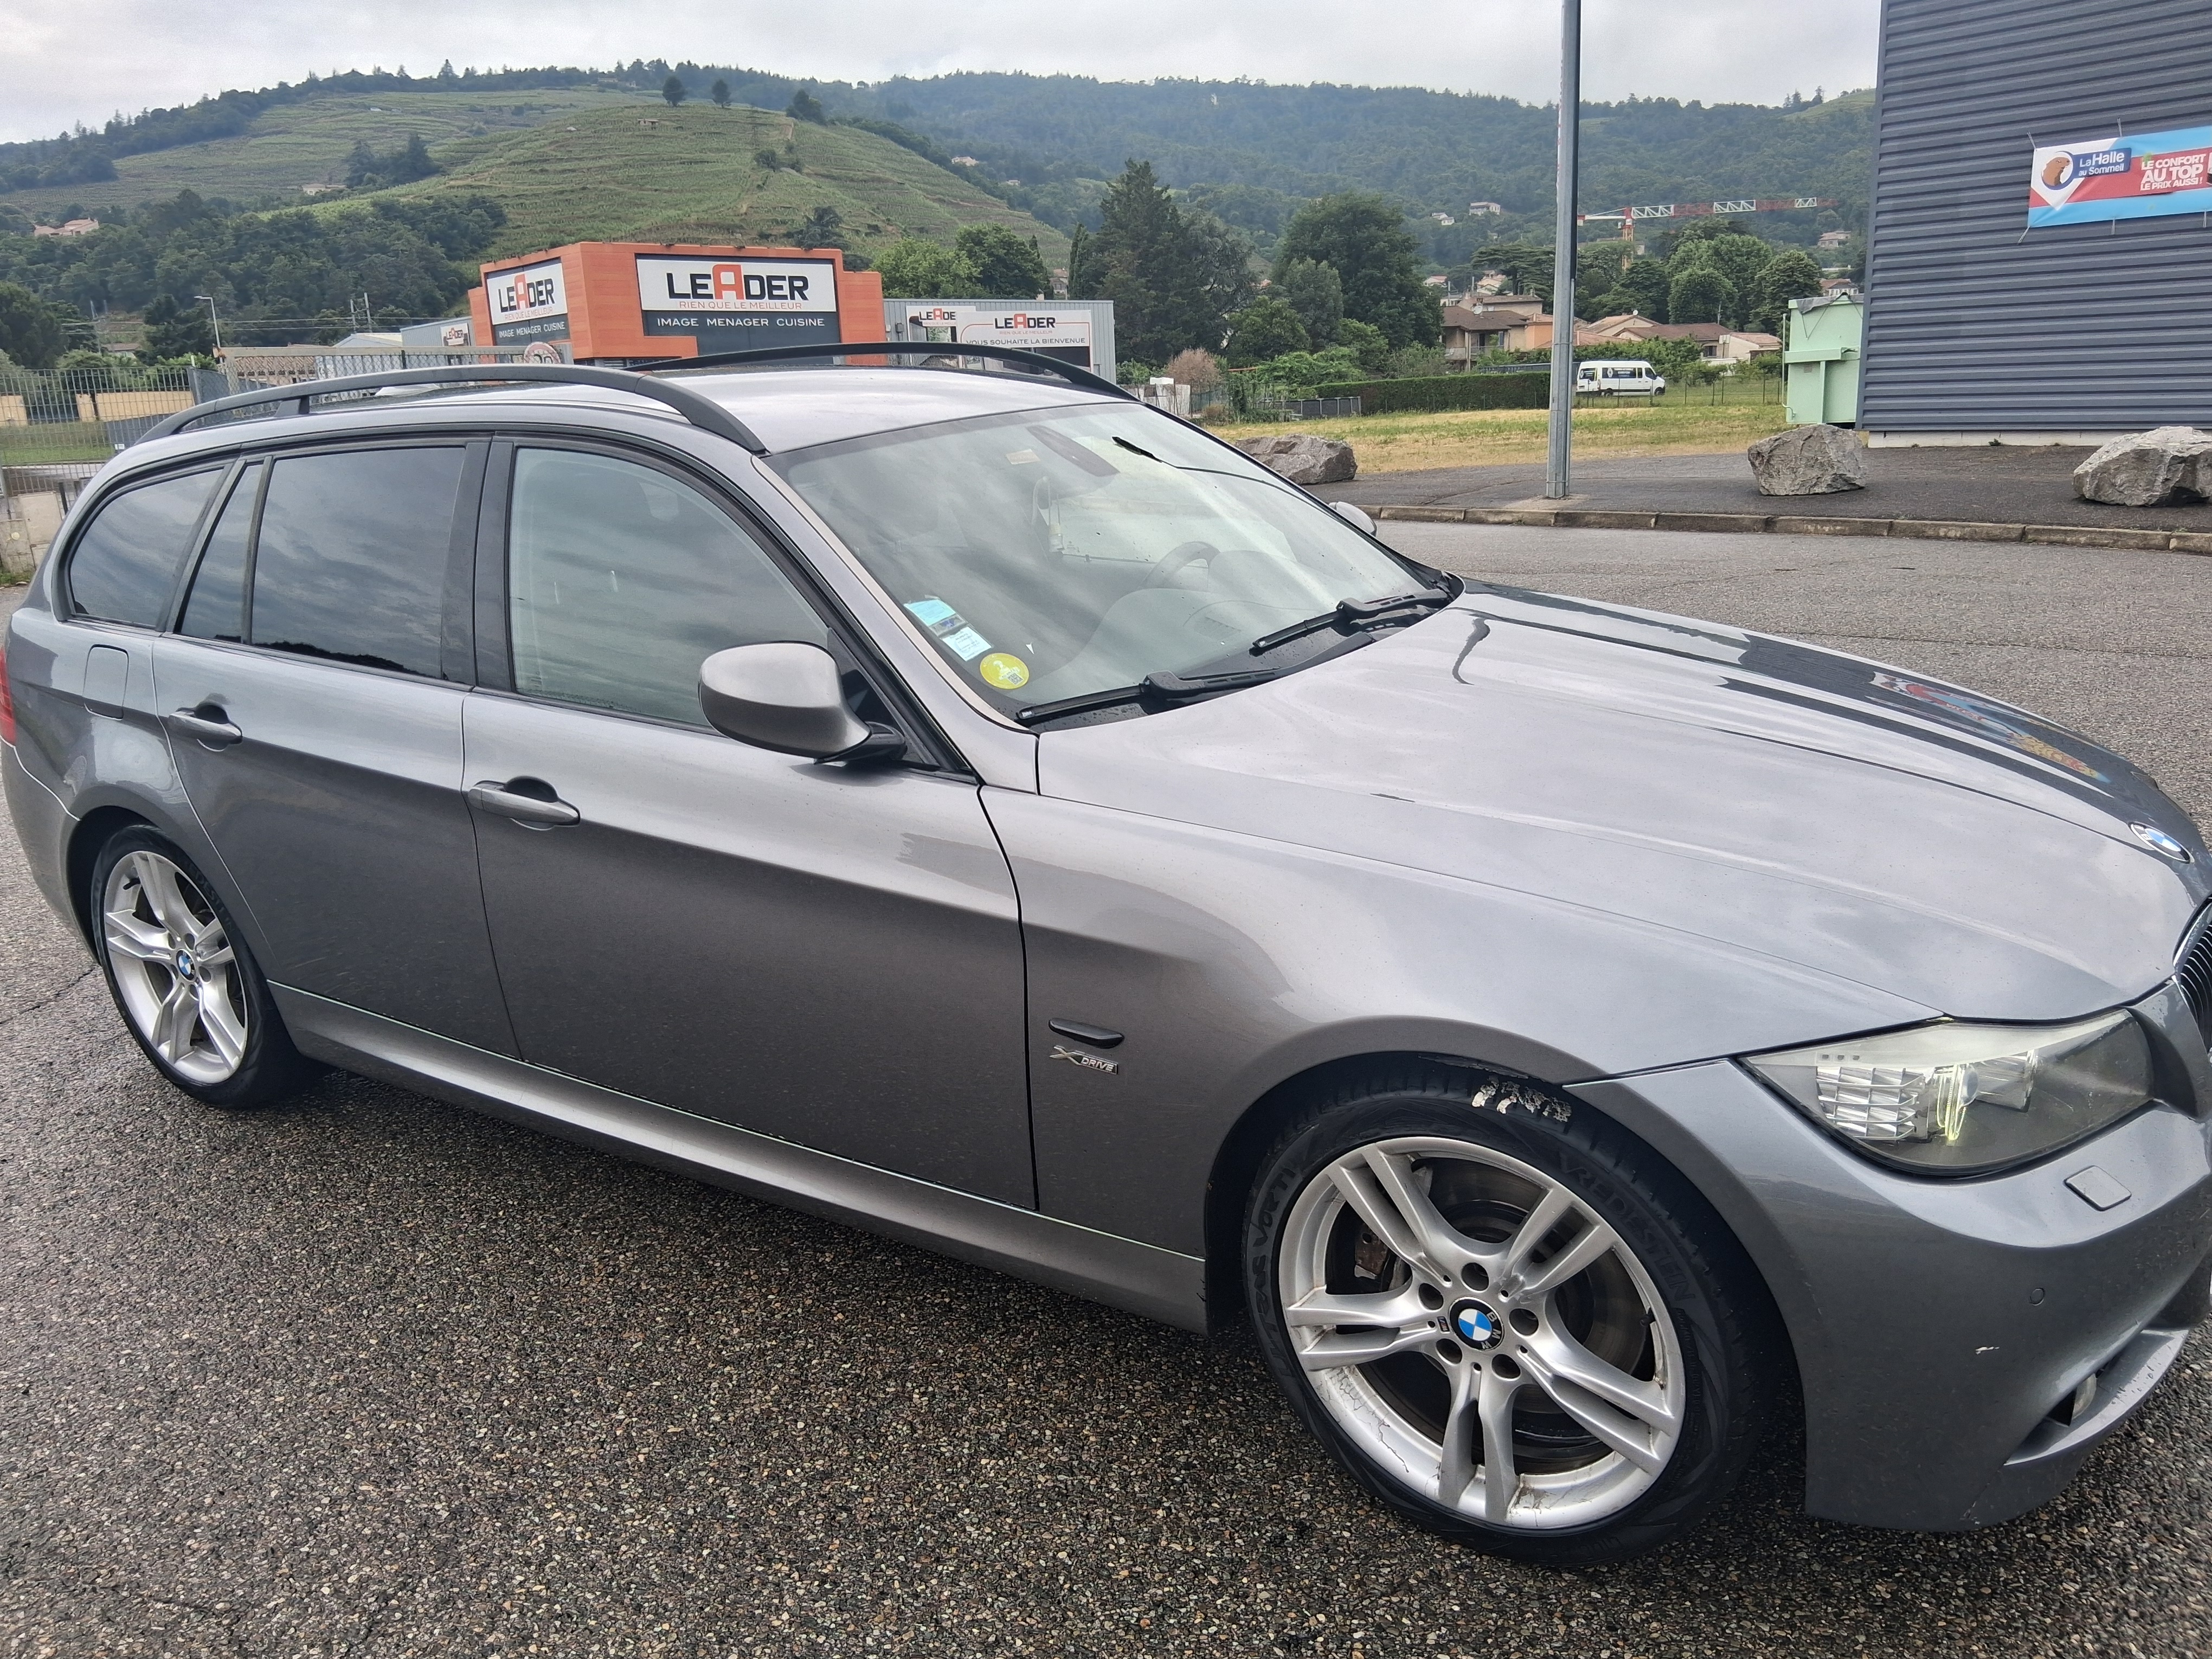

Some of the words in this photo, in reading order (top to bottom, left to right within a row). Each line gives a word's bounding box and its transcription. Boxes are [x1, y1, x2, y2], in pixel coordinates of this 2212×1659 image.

[2088, 163, 2124, 175] Sommeil
[2141, 160, 2154, 170] LE
[2156, 153, 2206, 169] CONFORT
[2141, 168, 2166, 184] AU
[2169, 164, 2203, 180] TOP
[2140, 183, 2151, 191] LE
[2152, 181, 2171, 189] PRIX
[666, 264, 809, 300] LEADER
[498, 274, 555, 312] LEADER
[531, 306, 553, 316] MEILLEUR
[919, 308, 956, 320] LEADE
[657, 318, 699, 326] IMAGE
[706, 318, 769, 326] MENAGER
[776, 318, 825, 326] CUISINE
[994, 313, 1056, 329] LEADER
[499, 329, 515, 338] IMAGE
[517, 325, 541, 336] MENAGER
[543, 321, 565, 332] CUISINE
